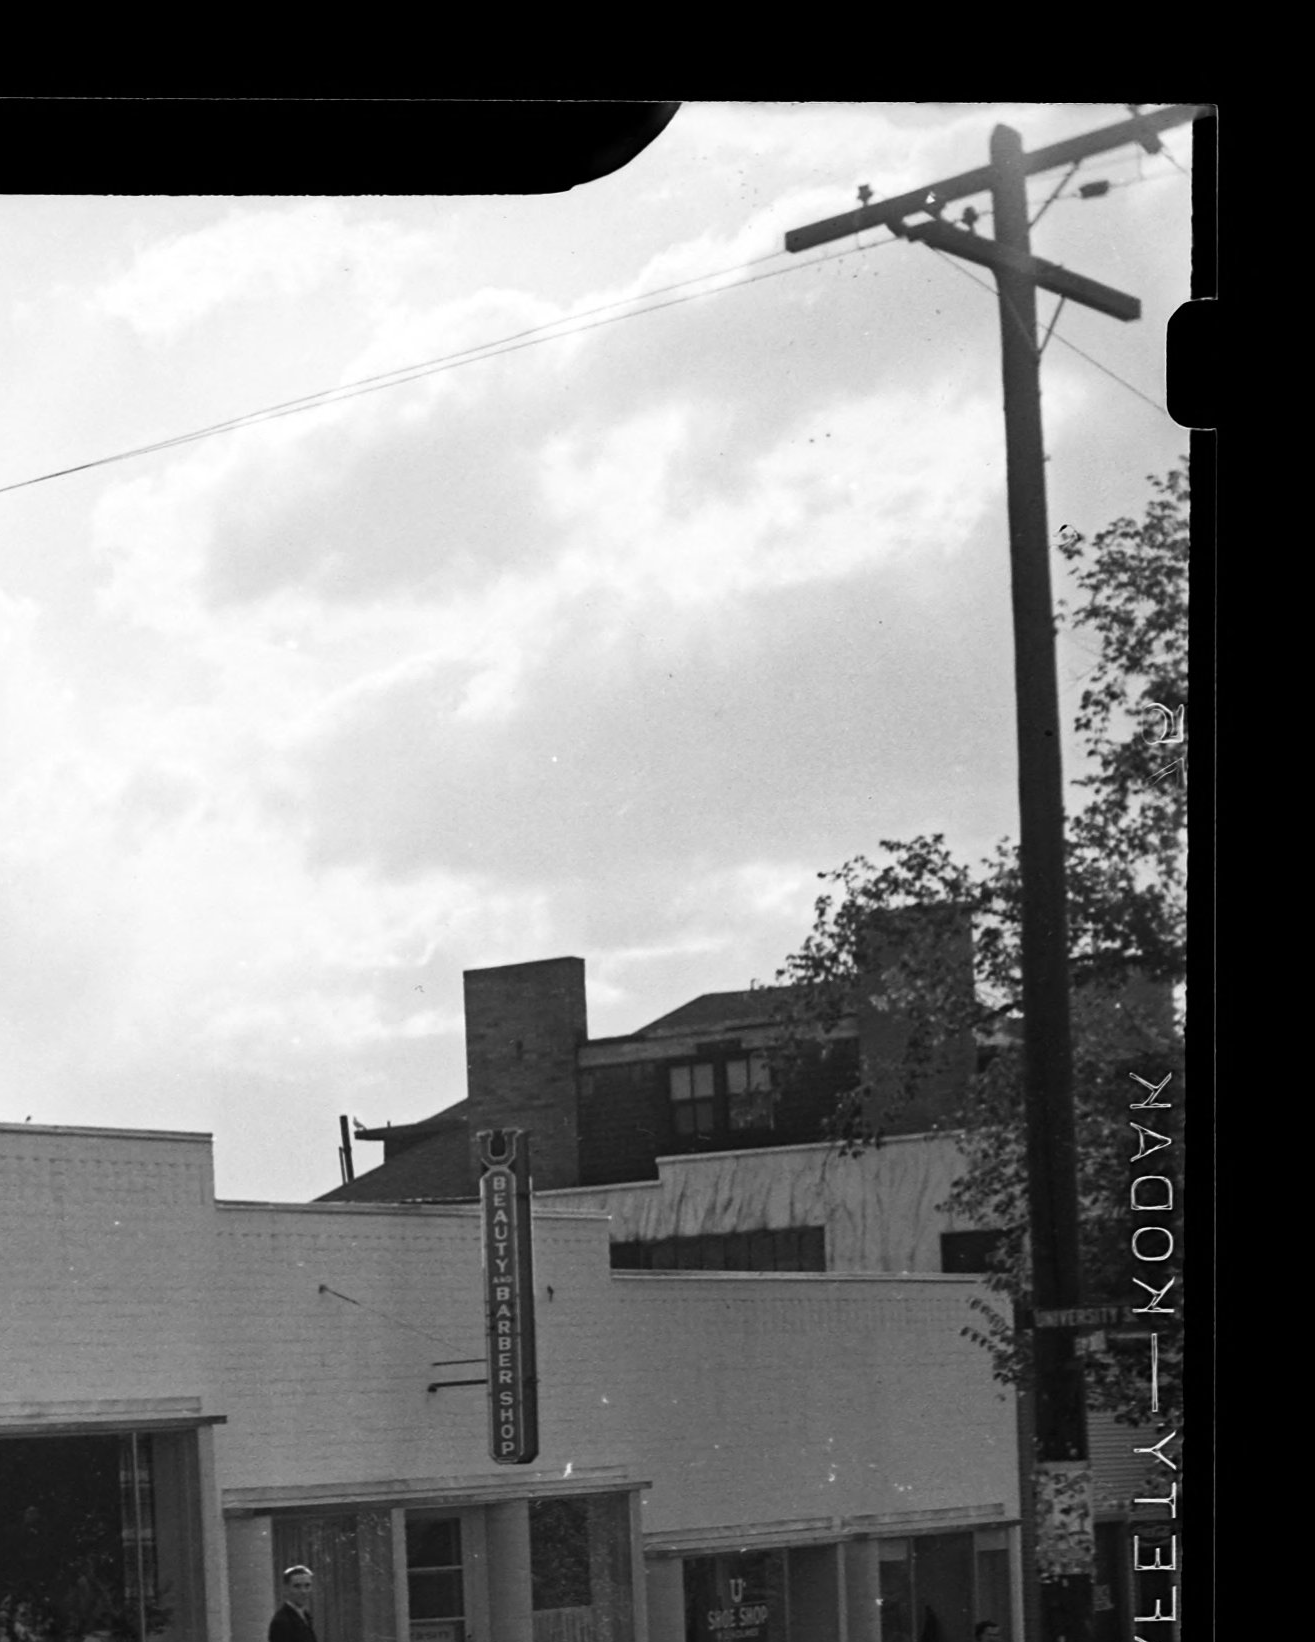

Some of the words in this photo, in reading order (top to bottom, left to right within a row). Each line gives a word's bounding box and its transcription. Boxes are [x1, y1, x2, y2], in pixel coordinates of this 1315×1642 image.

[492, 1176, 509, 1273] BEAUTY
[492, 1275, 513, 1284] AND
[496, 1286, 513, 1384] BARBER
[499, 1391, 515, 1455] SHOP
[707, 1609, 736, 1631] SHOE
[739, 1605, 768, 1627] SHOP
